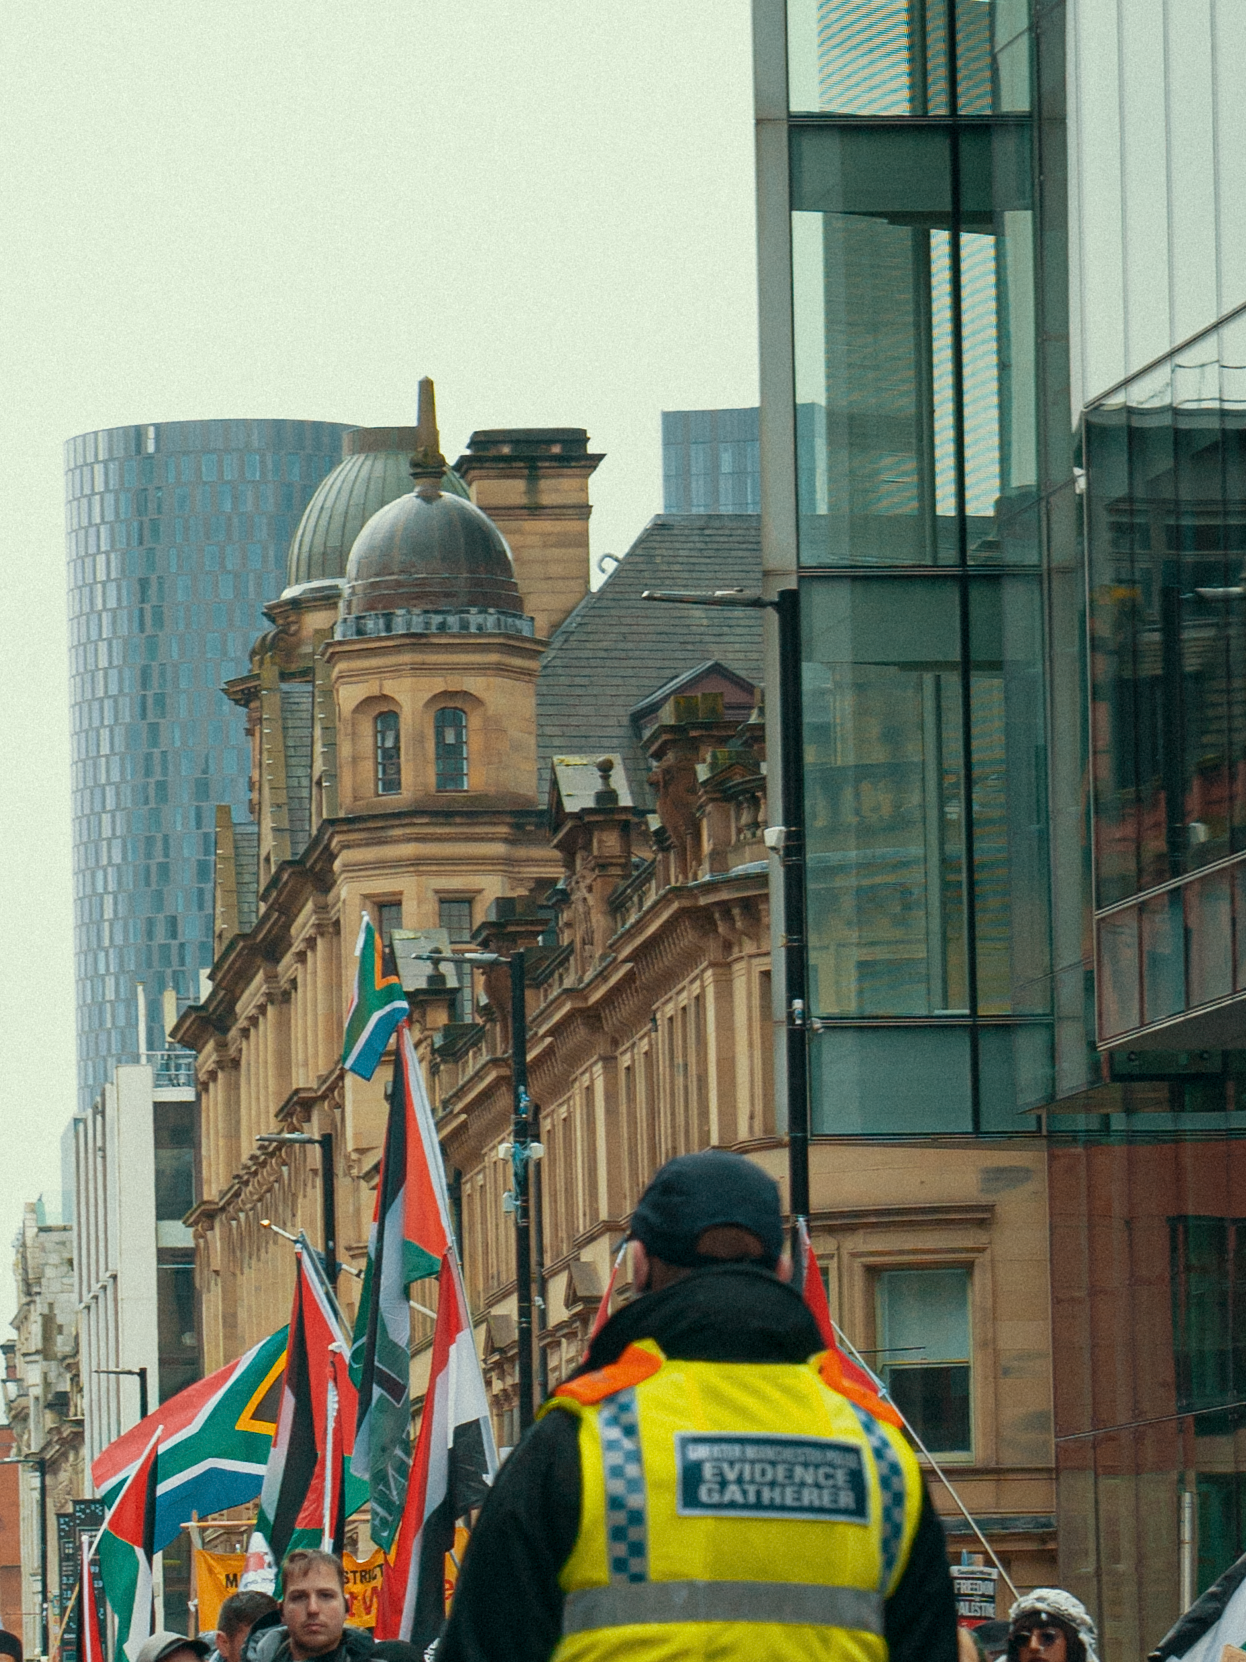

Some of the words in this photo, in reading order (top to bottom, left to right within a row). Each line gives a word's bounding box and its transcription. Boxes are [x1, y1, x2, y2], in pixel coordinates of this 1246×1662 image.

[702, 1462, 851, 1488] EVIDENCE
[698, 1483, 856, 1509] GATHERER
[344, 1563, 384, 1588] STRICT
[955, 1580, 995, 1596] FREEDOM
